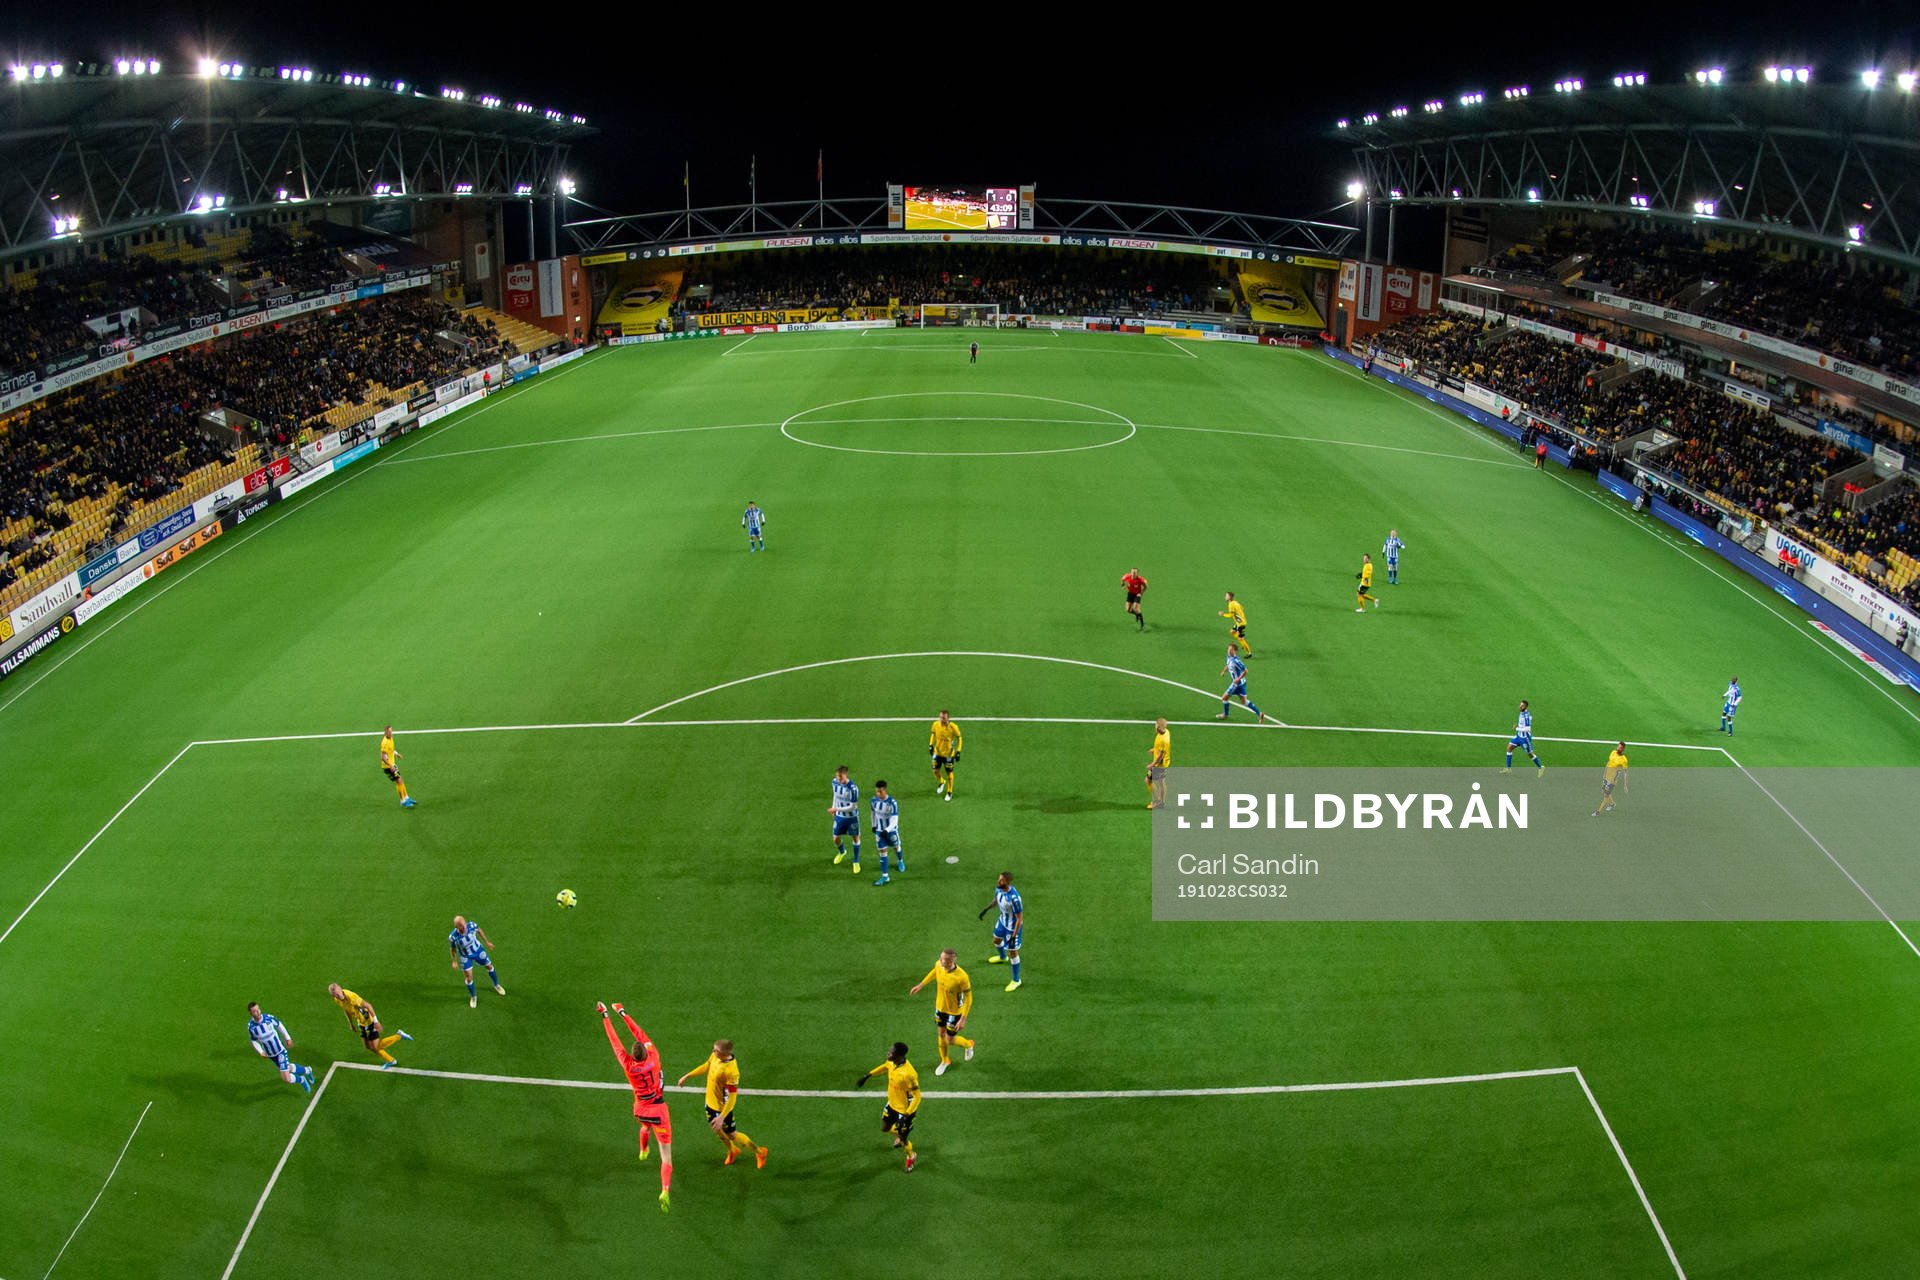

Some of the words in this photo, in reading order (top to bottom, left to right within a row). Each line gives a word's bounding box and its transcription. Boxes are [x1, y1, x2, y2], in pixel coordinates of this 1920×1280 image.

[990, 204, 1013, 212] 43:09
[766, 238, 809, 247] PULSEN
[1111, 239, 1155, 249] PULSEN
[229, 313, 261, 331] PULSEN
[54, 366, 96, 389] Sparbanken
[96, 355, 126, 373] Sjuhärad
[250, 462, 283, 489] elceter
[88, 557, 117, 579] Danske
[119, 545, 138, 560] Bank
[20, 581, 73, 628] Sandwall
[77, 590, 115, 621] Sparbanken
[115, 571, 143, 597] Sjuhärad
[0, 626, 60, 675] TILLSAMMANS
